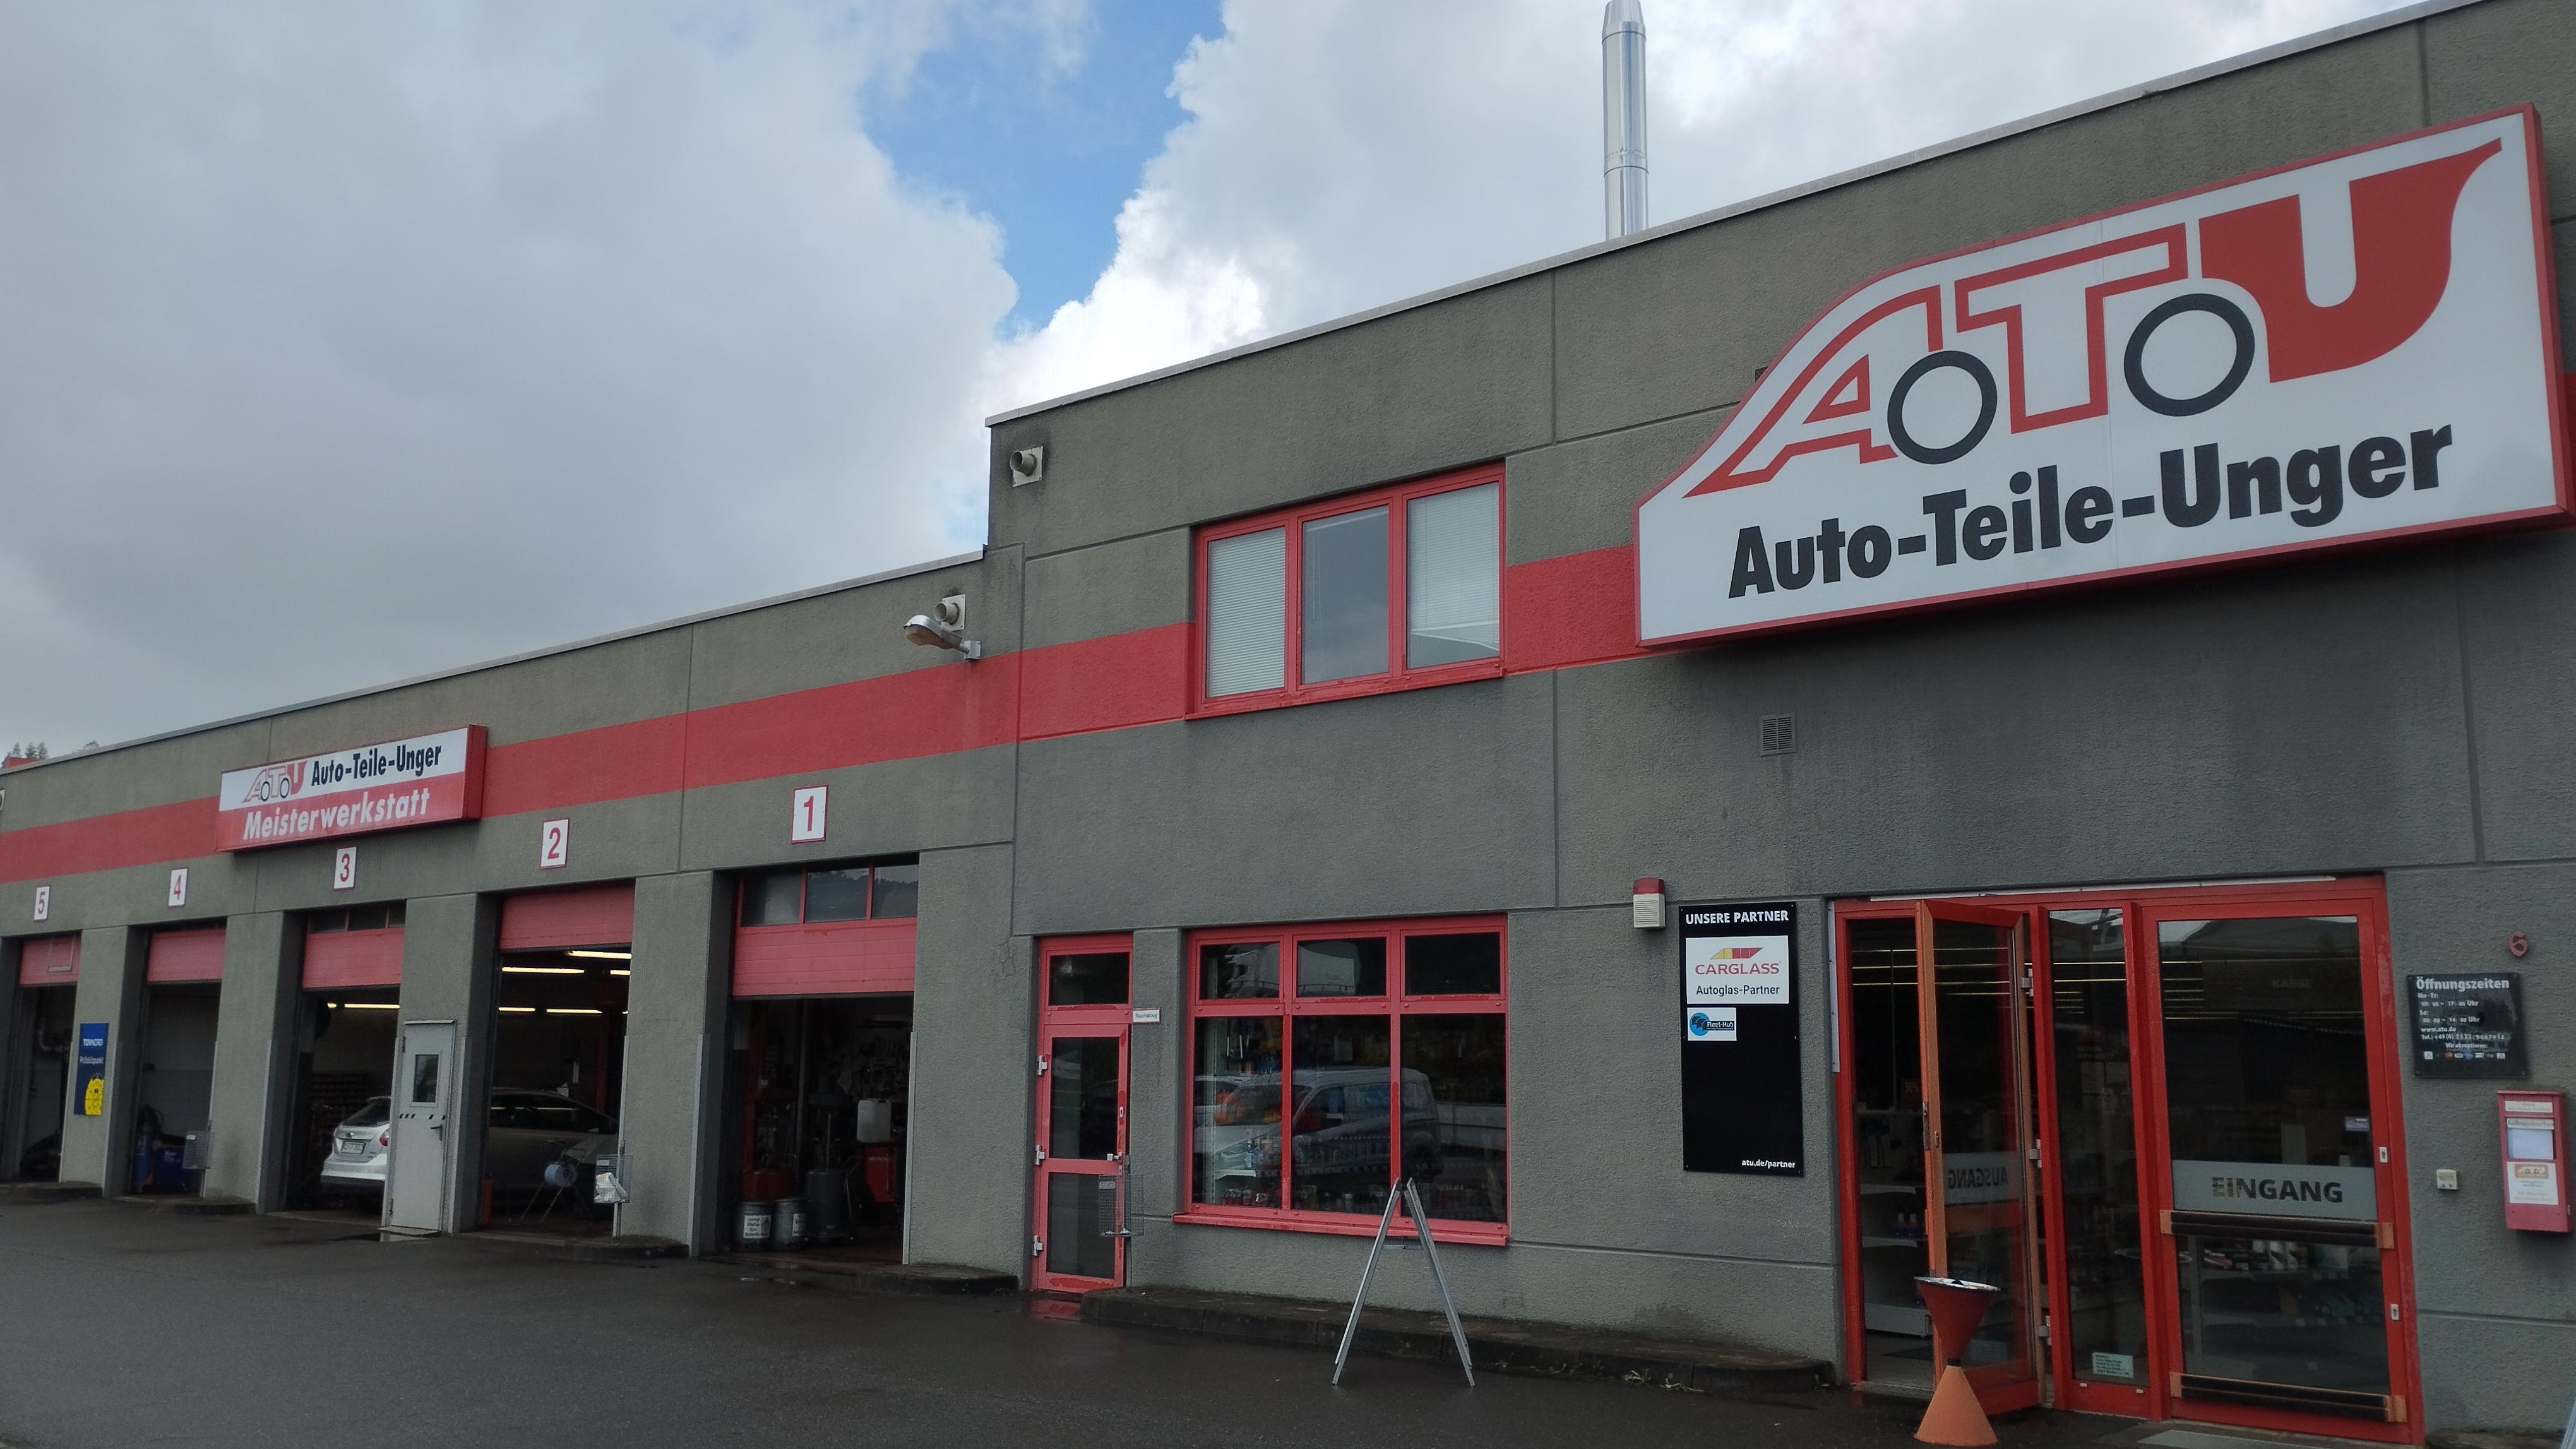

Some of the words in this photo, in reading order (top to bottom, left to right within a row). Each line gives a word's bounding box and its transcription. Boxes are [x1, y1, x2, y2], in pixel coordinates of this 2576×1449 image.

[1727, 424, 2453, 599] Auto-Teile-Unger
[311, 744, 441, 787] Auto-Teile-Unger
[243, 788, 430, 840] Meisterwerkstatt
[804, 795, 814, 832] 1
[547, 827, 561, 860] 2
[340, 853, 350, 883] 3
[174, 874, 182, 900] 4
[38, 891, 46, 914] 5
[1685, 912, 1731, 925] UNSERE
[1734, 910, 1789, 923] PARTNER
[2509, 931, 2529, 957] 6
[1695, 963, 1780, 975] CARGLASS
[1696, 984, 1780, 997] Autoglas-Partner
[2416, 976, 2510, 993] Öffnungszeiten
[1741, 1159, 1796, 1169] atu.de/partner
[2211, 1176, 2343, 1203] EINGANG
